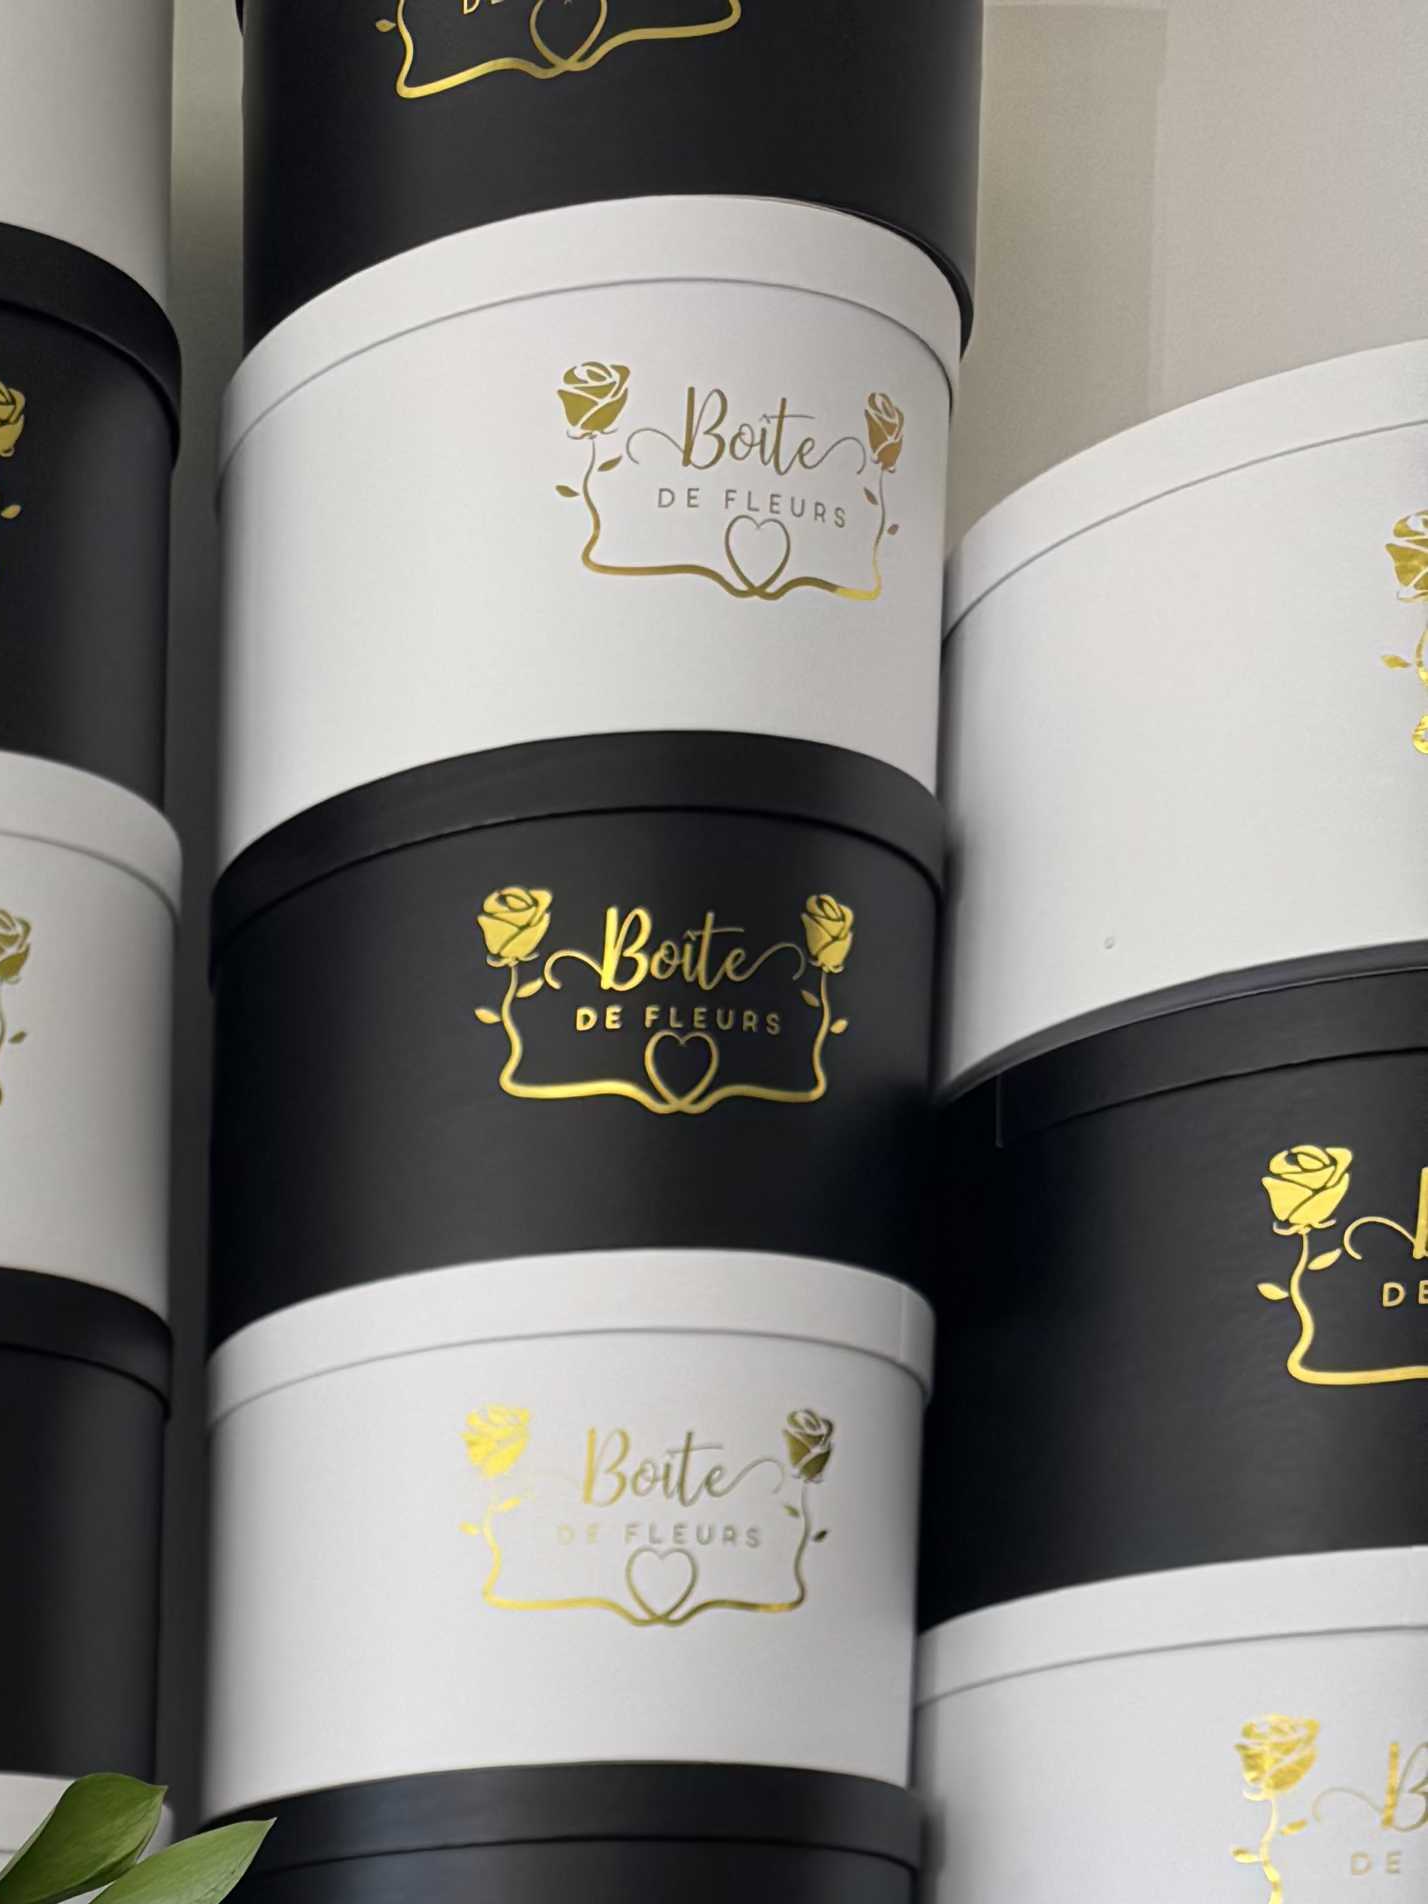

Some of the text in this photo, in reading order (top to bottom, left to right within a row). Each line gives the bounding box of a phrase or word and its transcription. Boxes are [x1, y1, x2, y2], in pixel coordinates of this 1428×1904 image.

[658, 487, 847, 528] DE FLEURS
[576, 1006, 782, 1035] DE FLEURS
[556, 1522, 762, 1549] DE FLEURS
[1352, 1852, 1403, 1877] DE
